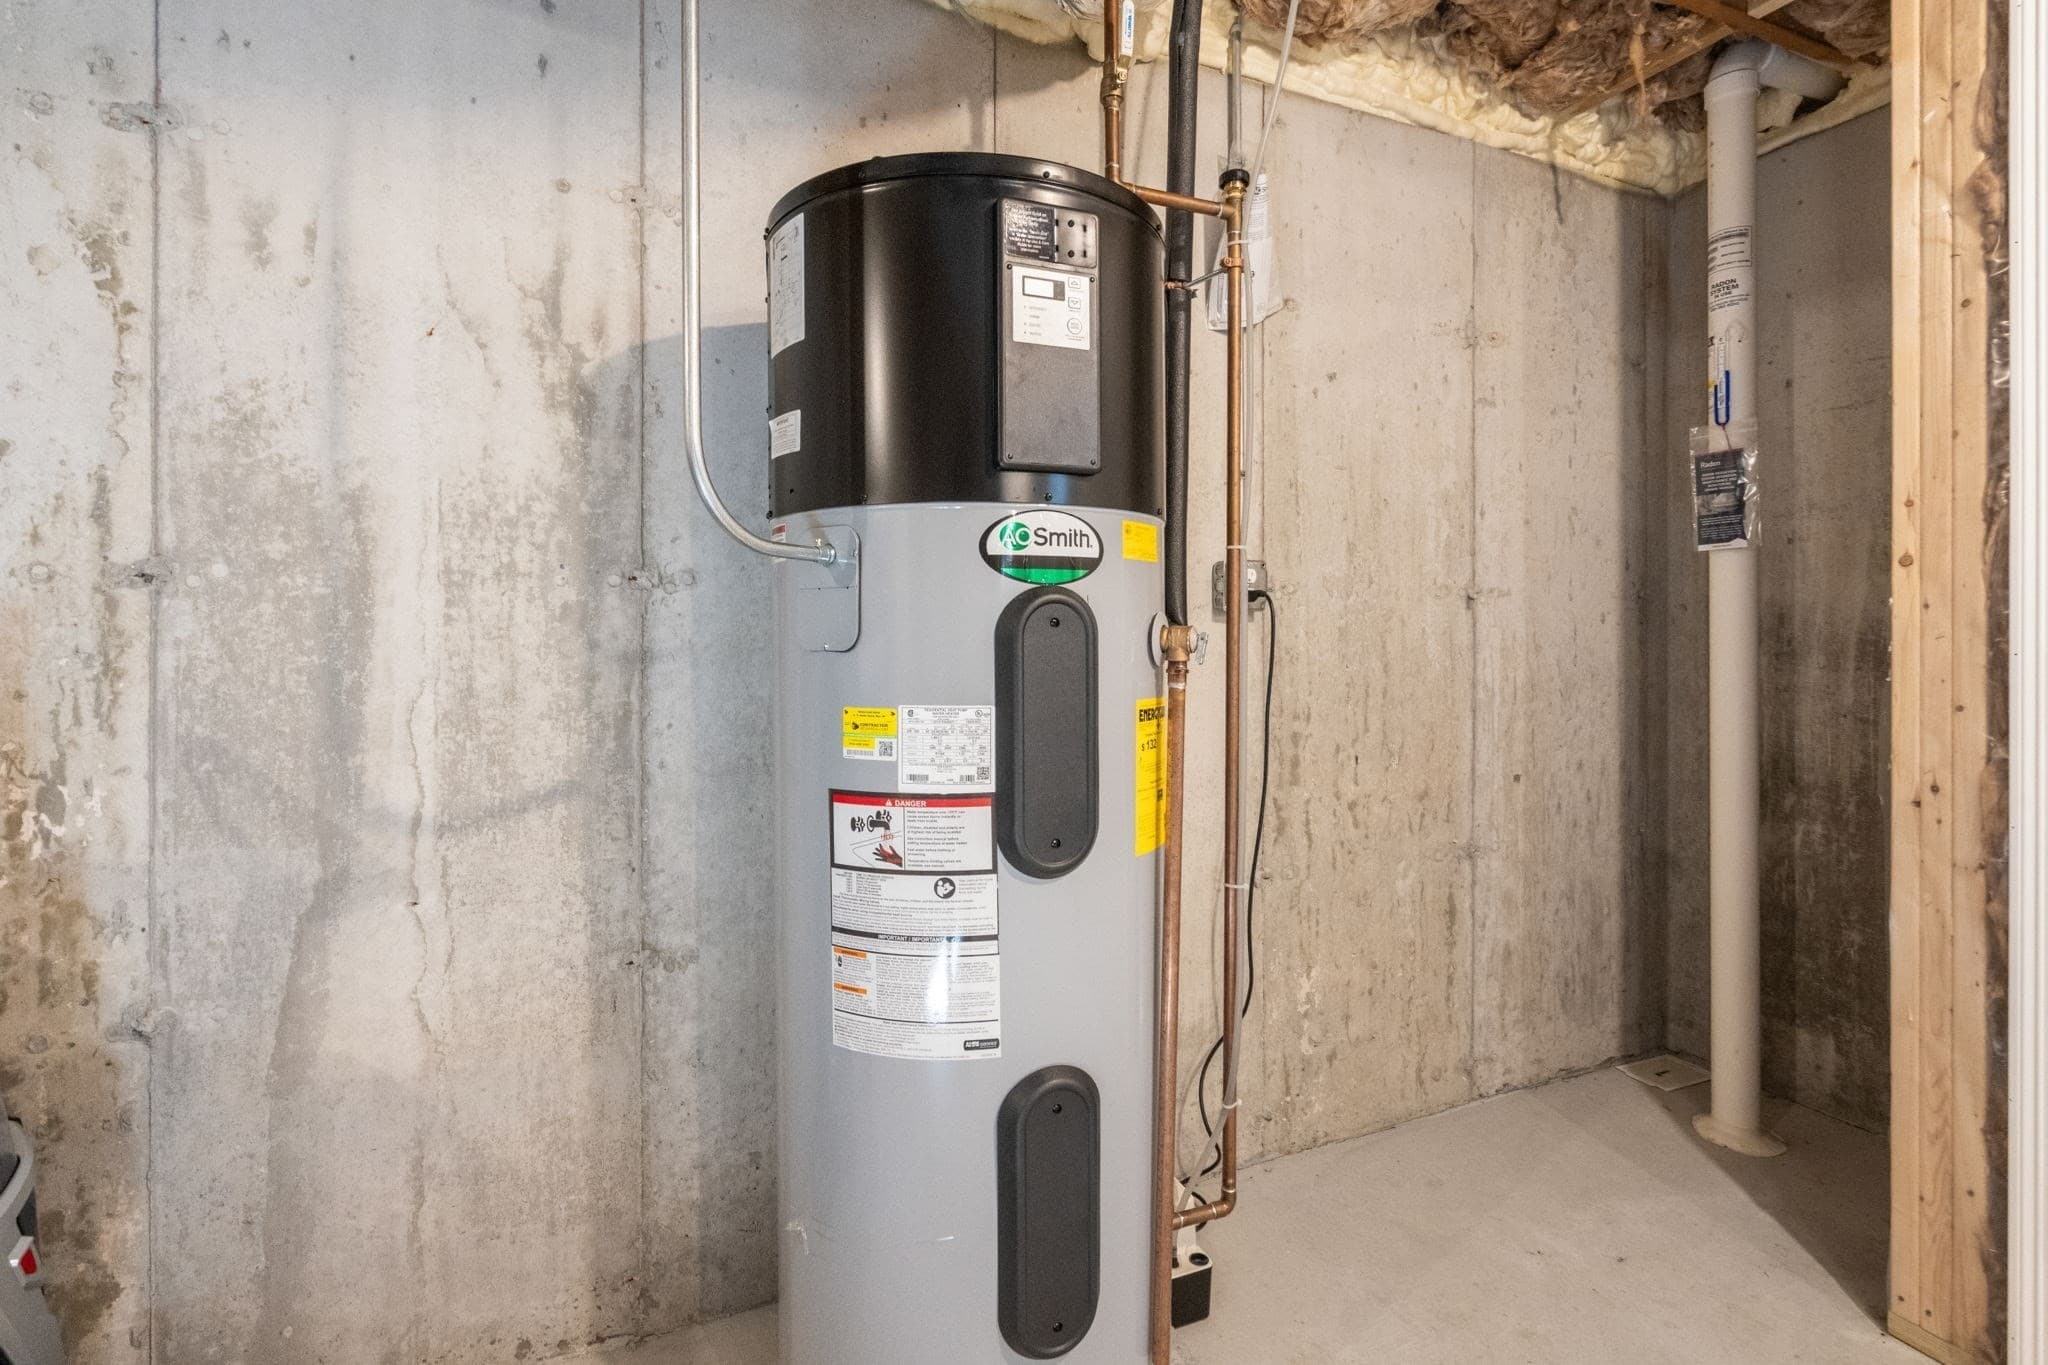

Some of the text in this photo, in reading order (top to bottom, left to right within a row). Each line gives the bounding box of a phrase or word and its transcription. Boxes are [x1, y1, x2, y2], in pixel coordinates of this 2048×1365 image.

[1711, 278, 1736, 289] RADON
[1710, 284, 1739, 297] SYSTEM
[877, 934, 908, 942] IMPORTANT
